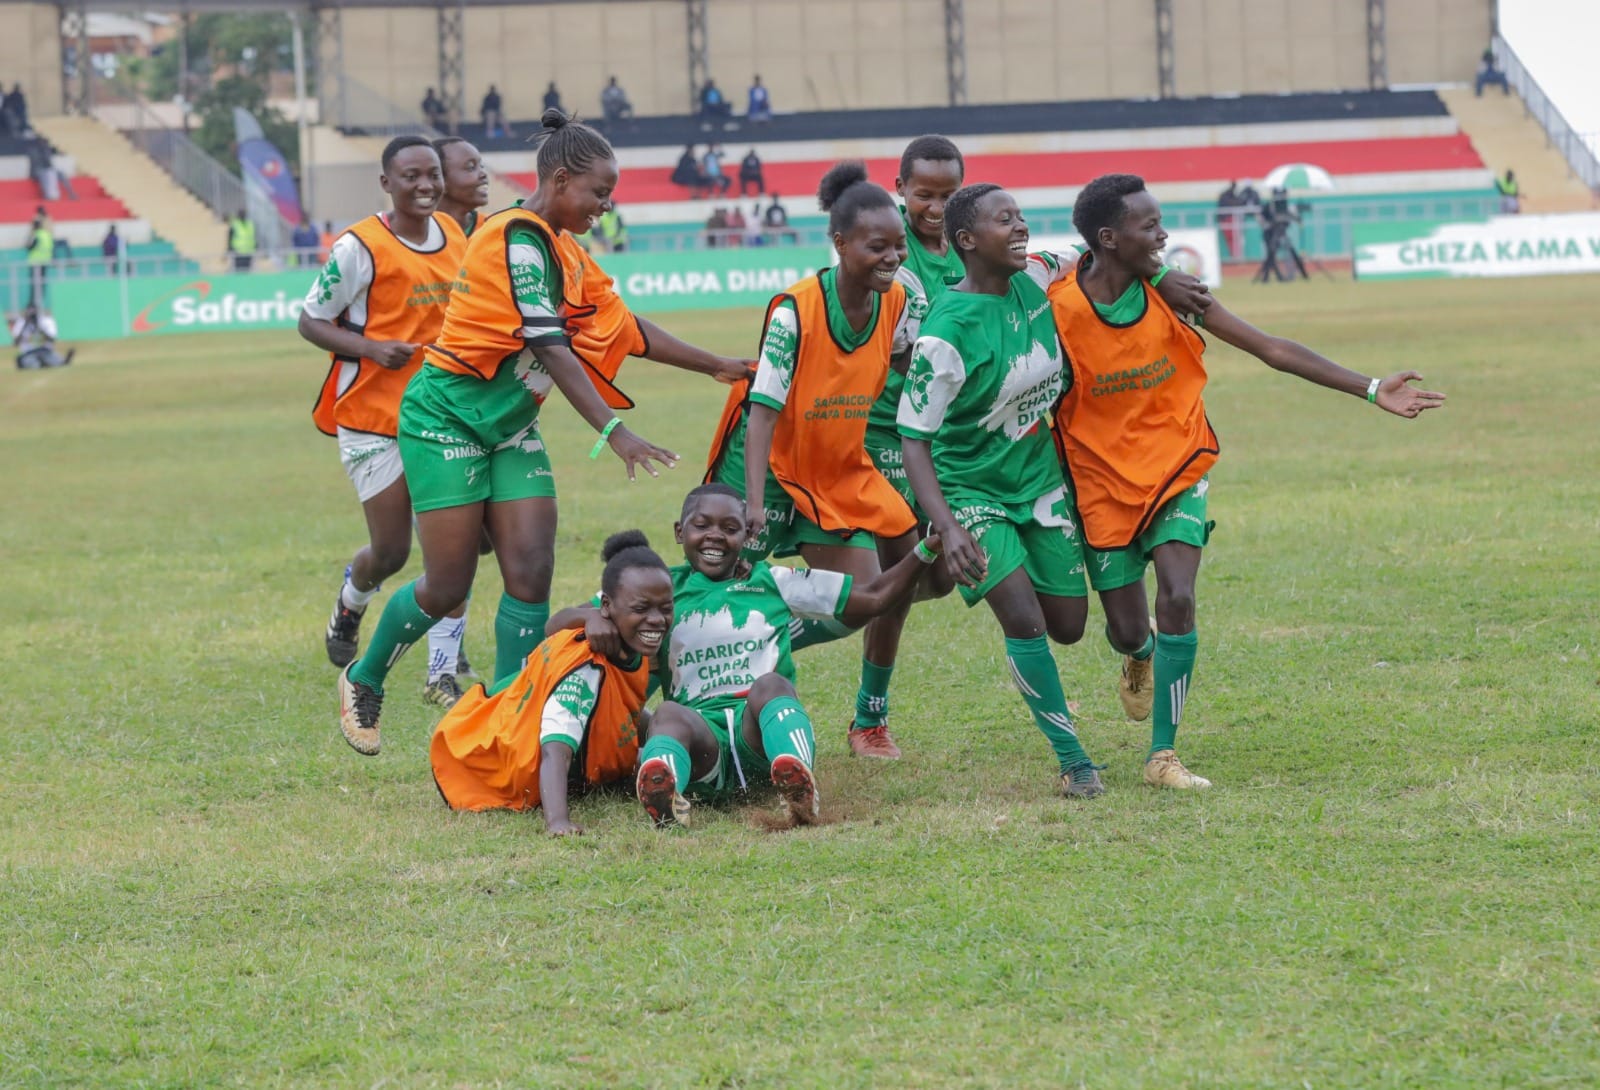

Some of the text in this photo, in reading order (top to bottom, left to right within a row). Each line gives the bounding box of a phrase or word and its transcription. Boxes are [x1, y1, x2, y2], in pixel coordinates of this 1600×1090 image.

[1398, 241, 1488, 265] CHEZA
[1496, 237, 1582, 261] KAMA
[627, 271, 722, 297] CHAPA
[1096, 354, 1168, 384] SAFARICOM
[1091, 380, 1139, 398] CHAPA
[443, 445, 485, 461] DIMBA
[698, 657, 750, 680] CHAPA
